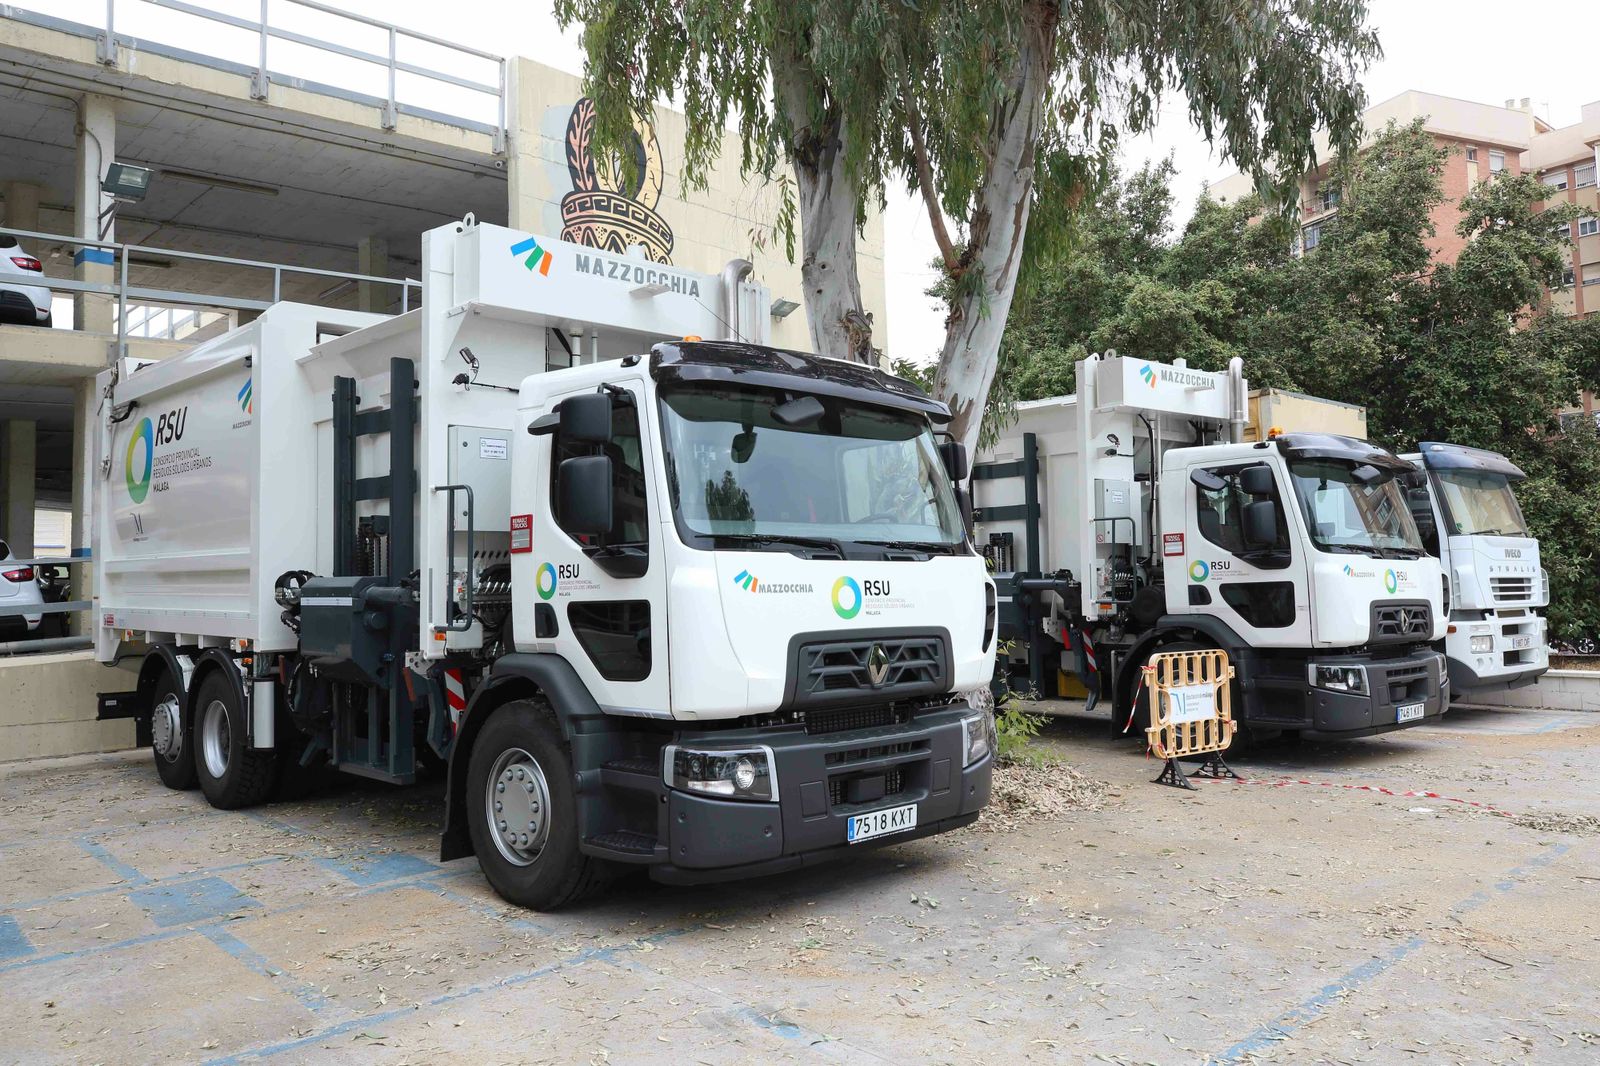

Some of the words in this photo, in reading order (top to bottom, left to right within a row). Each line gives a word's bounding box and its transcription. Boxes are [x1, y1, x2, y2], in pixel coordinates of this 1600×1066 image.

[576, 253, 700, 298] MAZZOCCHIA
[1160, 369, 1216, 390] MAZZOCCHIA
[155, 406, 188, 447] RSU
[1504, 549, 1522, 559] IVECO
[559, 564, 580, 579] RSU
[1211, 561, 1231, 570] RSU
[758, 583, 814, 594] MAZZOCCHIA
[864, 580, 890, 596] RSU
[856, 813, 887, 836] 7518
[891, 807, 914, 828] KXT
